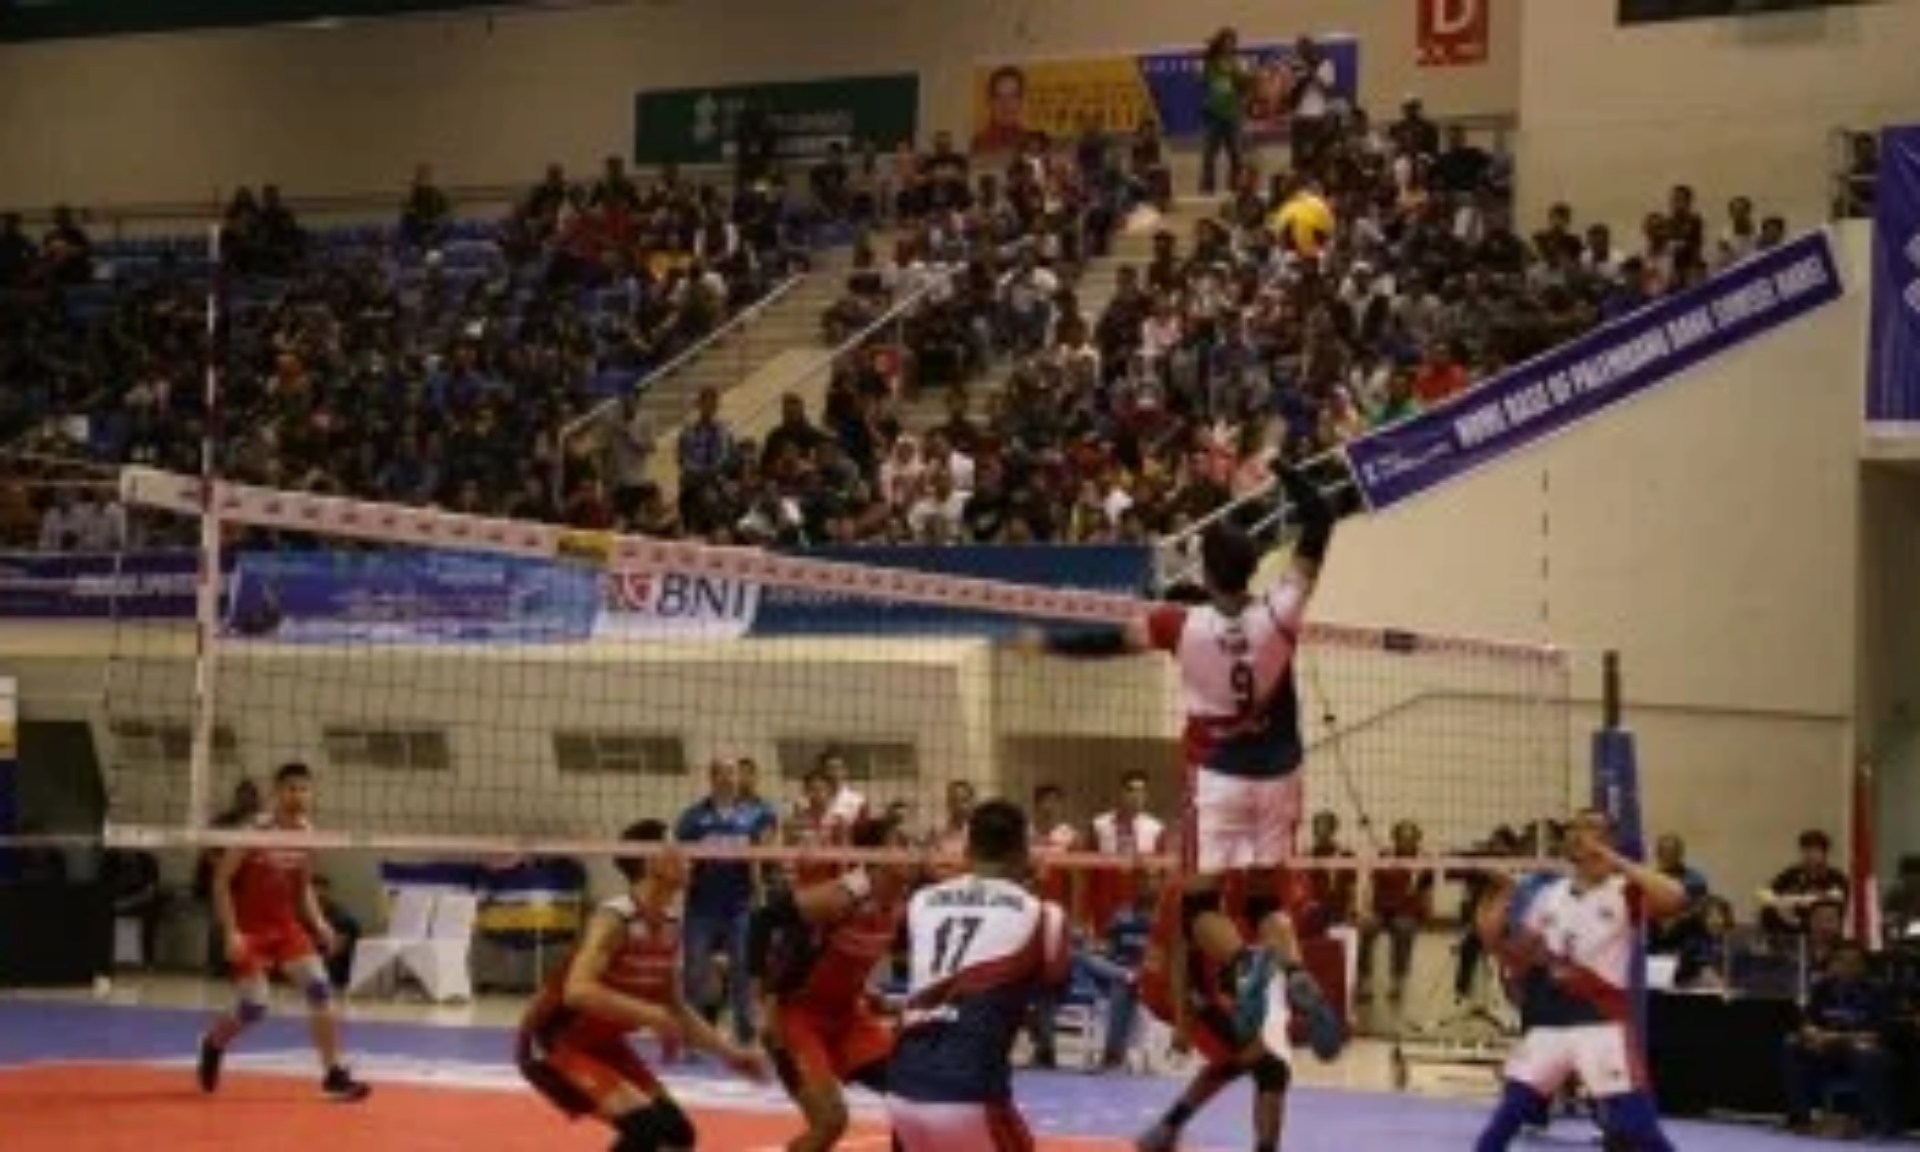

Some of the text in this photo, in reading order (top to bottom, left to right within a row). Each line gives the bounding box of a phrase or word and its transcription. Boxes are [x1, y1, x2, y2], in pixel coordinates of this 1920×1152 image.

[1432, 0, 1475, 34] D
[657, 571, 747, 618] BNI
[1231, 659, 1254, 713] 9
[930, 916, 984, 976] 17
